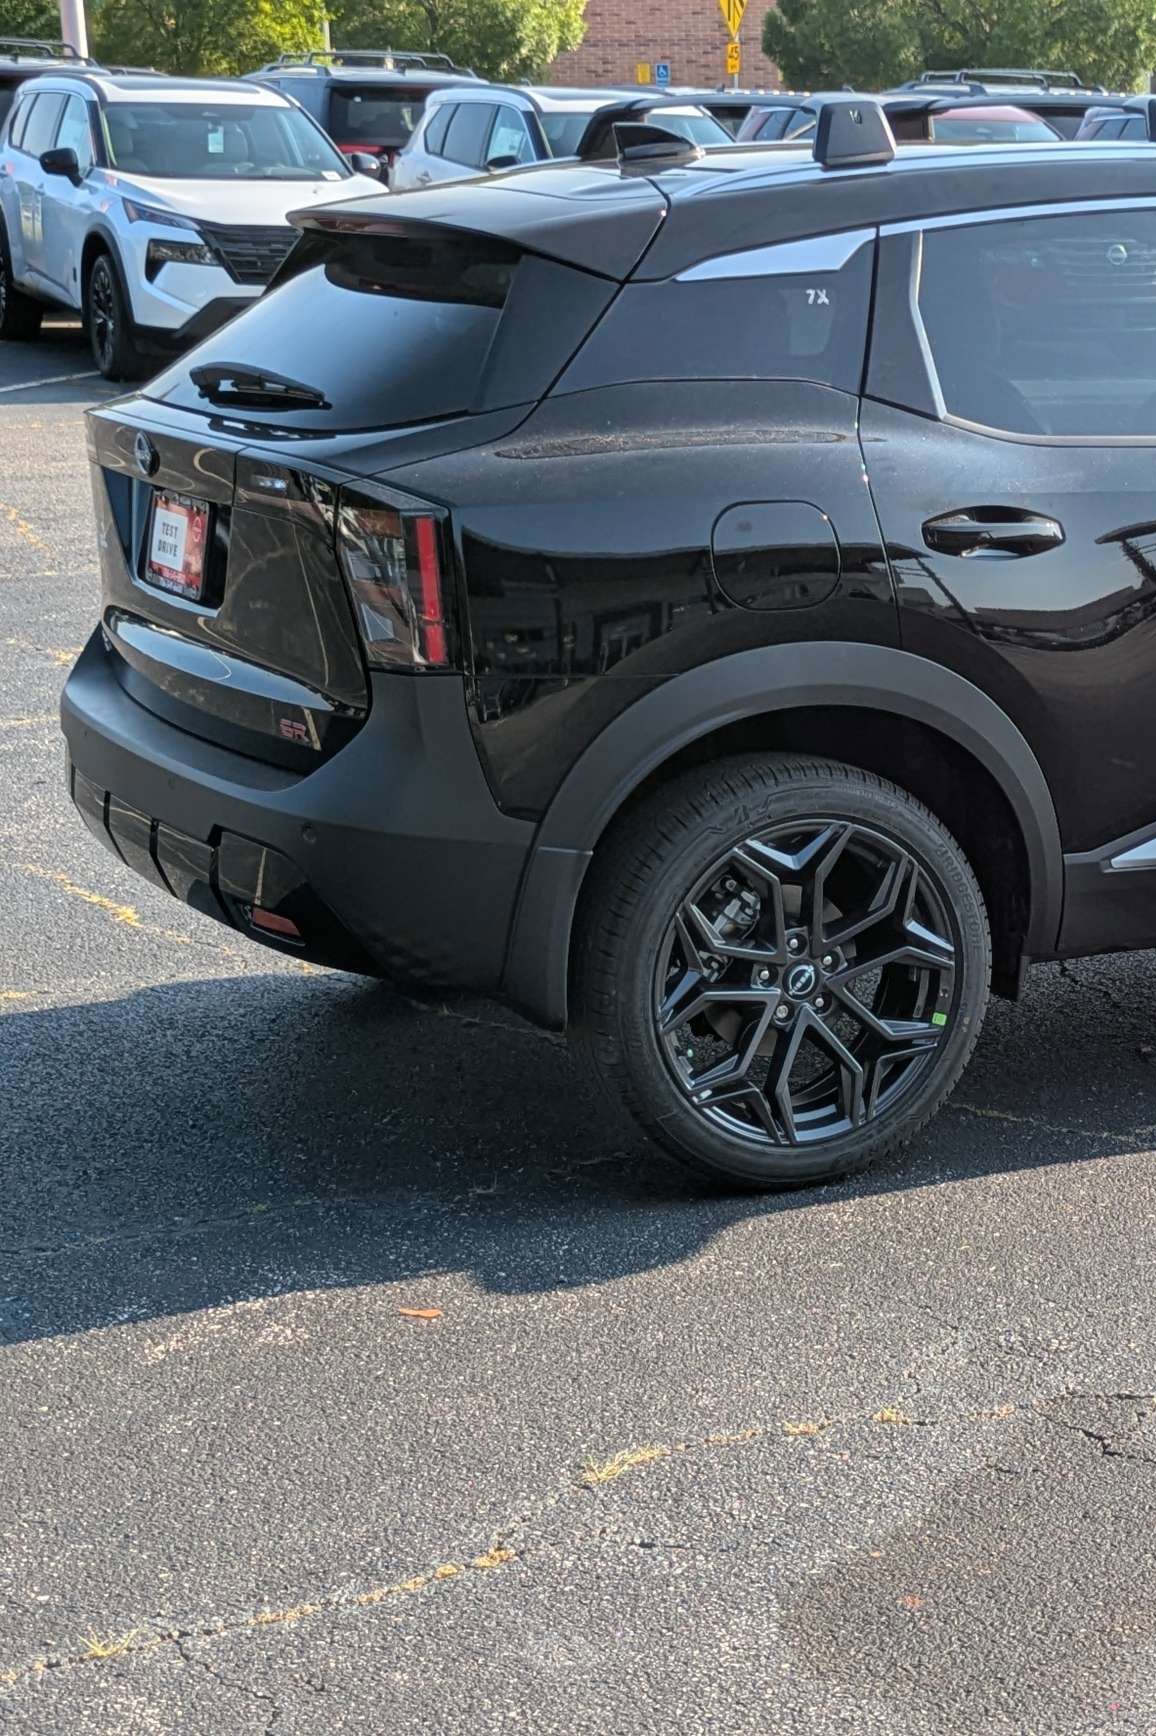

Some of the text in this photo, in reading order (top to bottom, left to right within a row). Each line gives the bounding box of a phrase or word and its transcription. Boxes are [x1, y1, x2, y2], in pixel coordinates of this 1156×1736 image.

[805, 288, 830, 305] 7X
[161, 521, 179, 538] TEST
[158, 539, 178, 557] DRIVE
